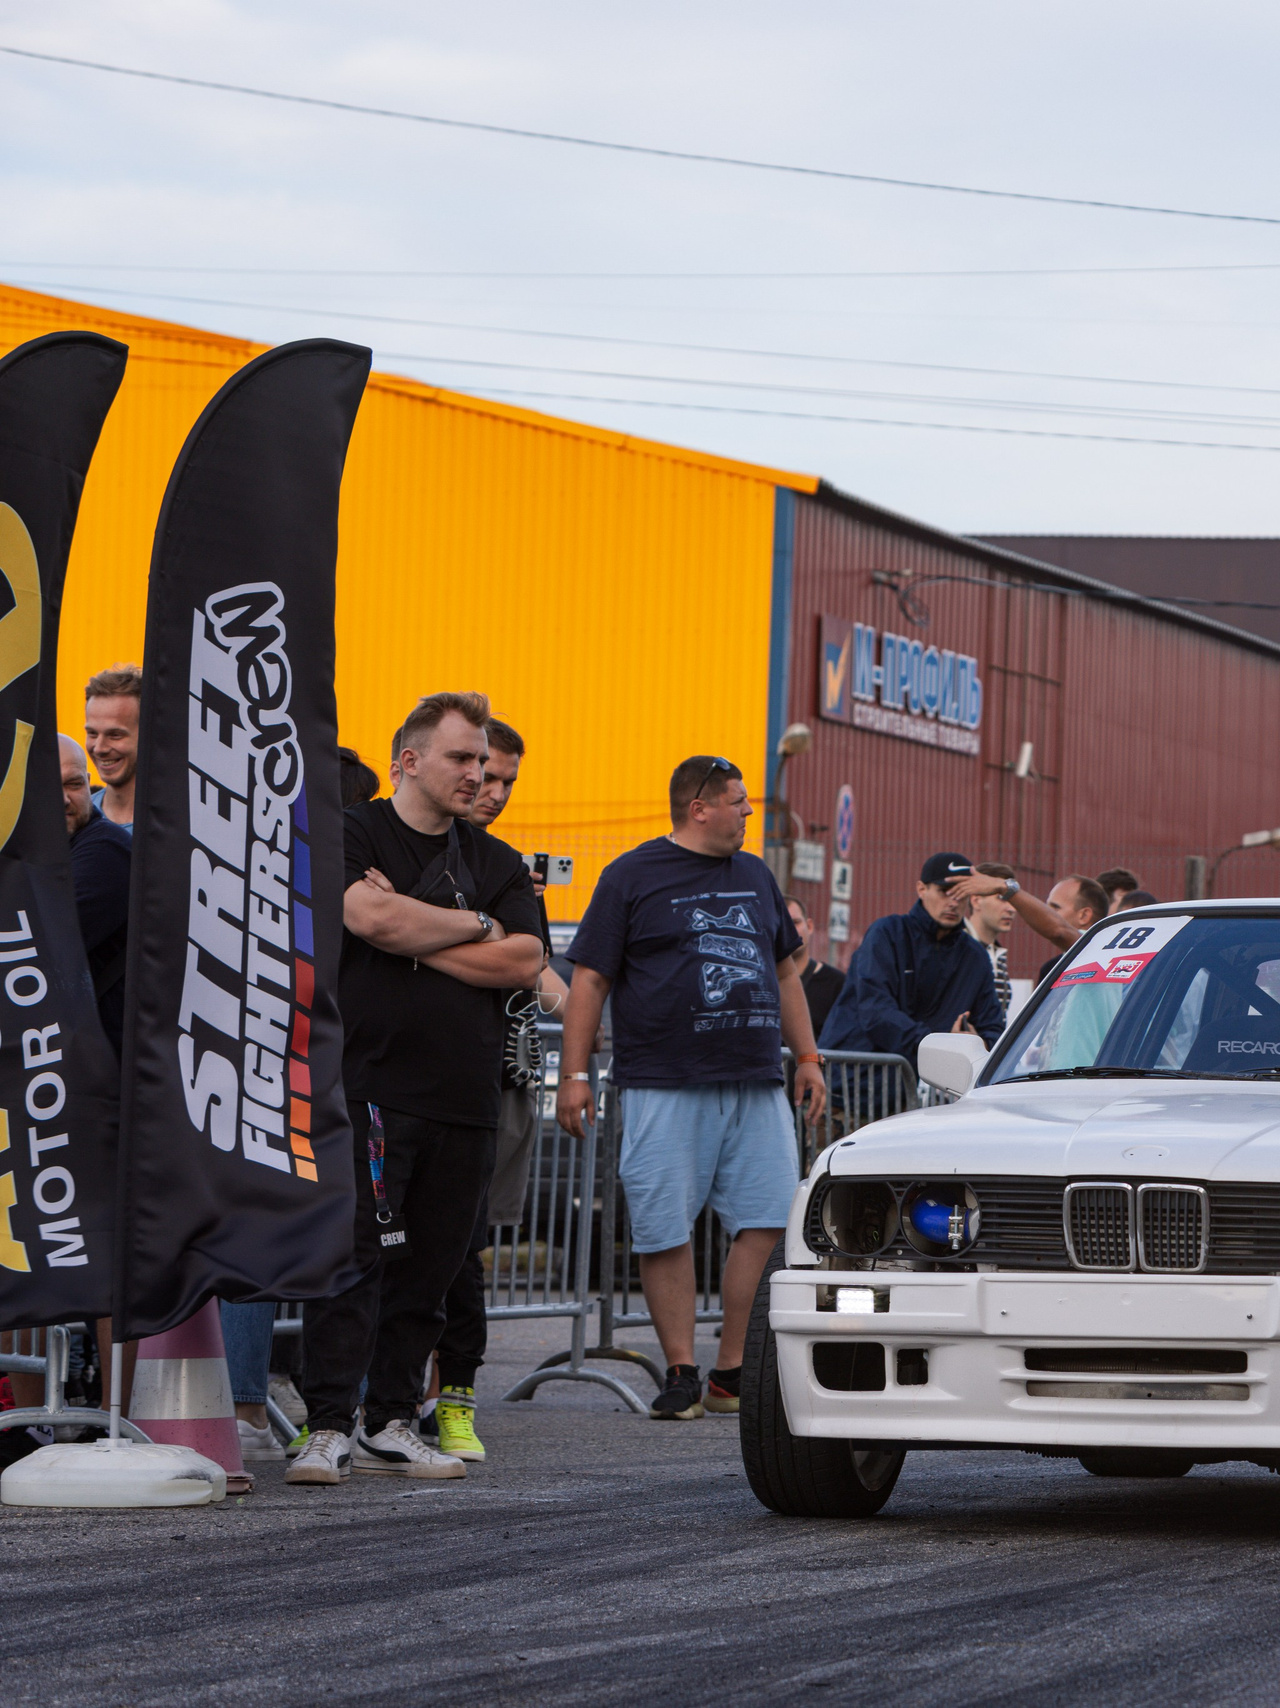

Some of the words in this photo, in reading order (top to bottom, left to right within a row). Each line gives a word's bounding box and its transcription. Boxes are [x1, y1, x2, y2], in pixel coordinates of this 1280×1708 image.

[852, 622, 984, 730] И-ПРОФИЛЬ
[177, 605, 250, 1154] STREET
[0, 909, 48, 1008] OIL
[241, 791, 292, 1174] FIGHTERS
[1102, 926, 1156, 950] 18
[21, 1022, 90, 1269] MOTOR
[380, 1230, 406, 1247] CREW
